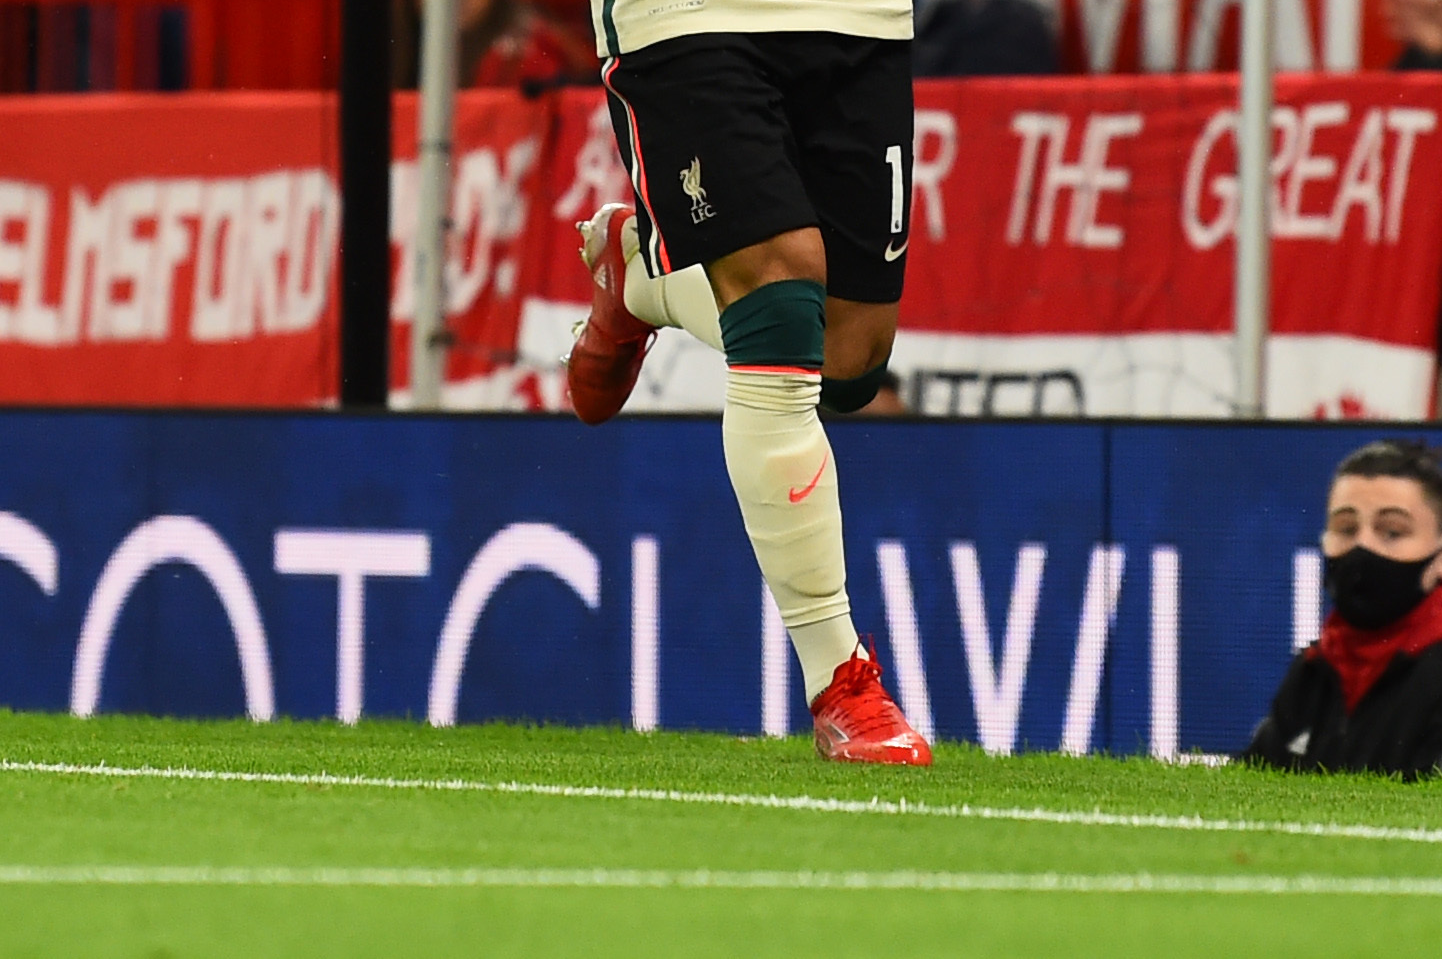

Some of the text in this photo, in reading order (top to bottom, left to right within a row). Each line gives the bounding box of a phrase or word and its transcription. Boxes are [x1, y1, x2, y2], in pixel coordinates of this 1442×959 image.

[691, 204, 718, 225] LFC
[886, 145, 904, 234] 1
[1006, 112, 1145, 248] THE
[1182, 101, 1437, 250] GREAT
